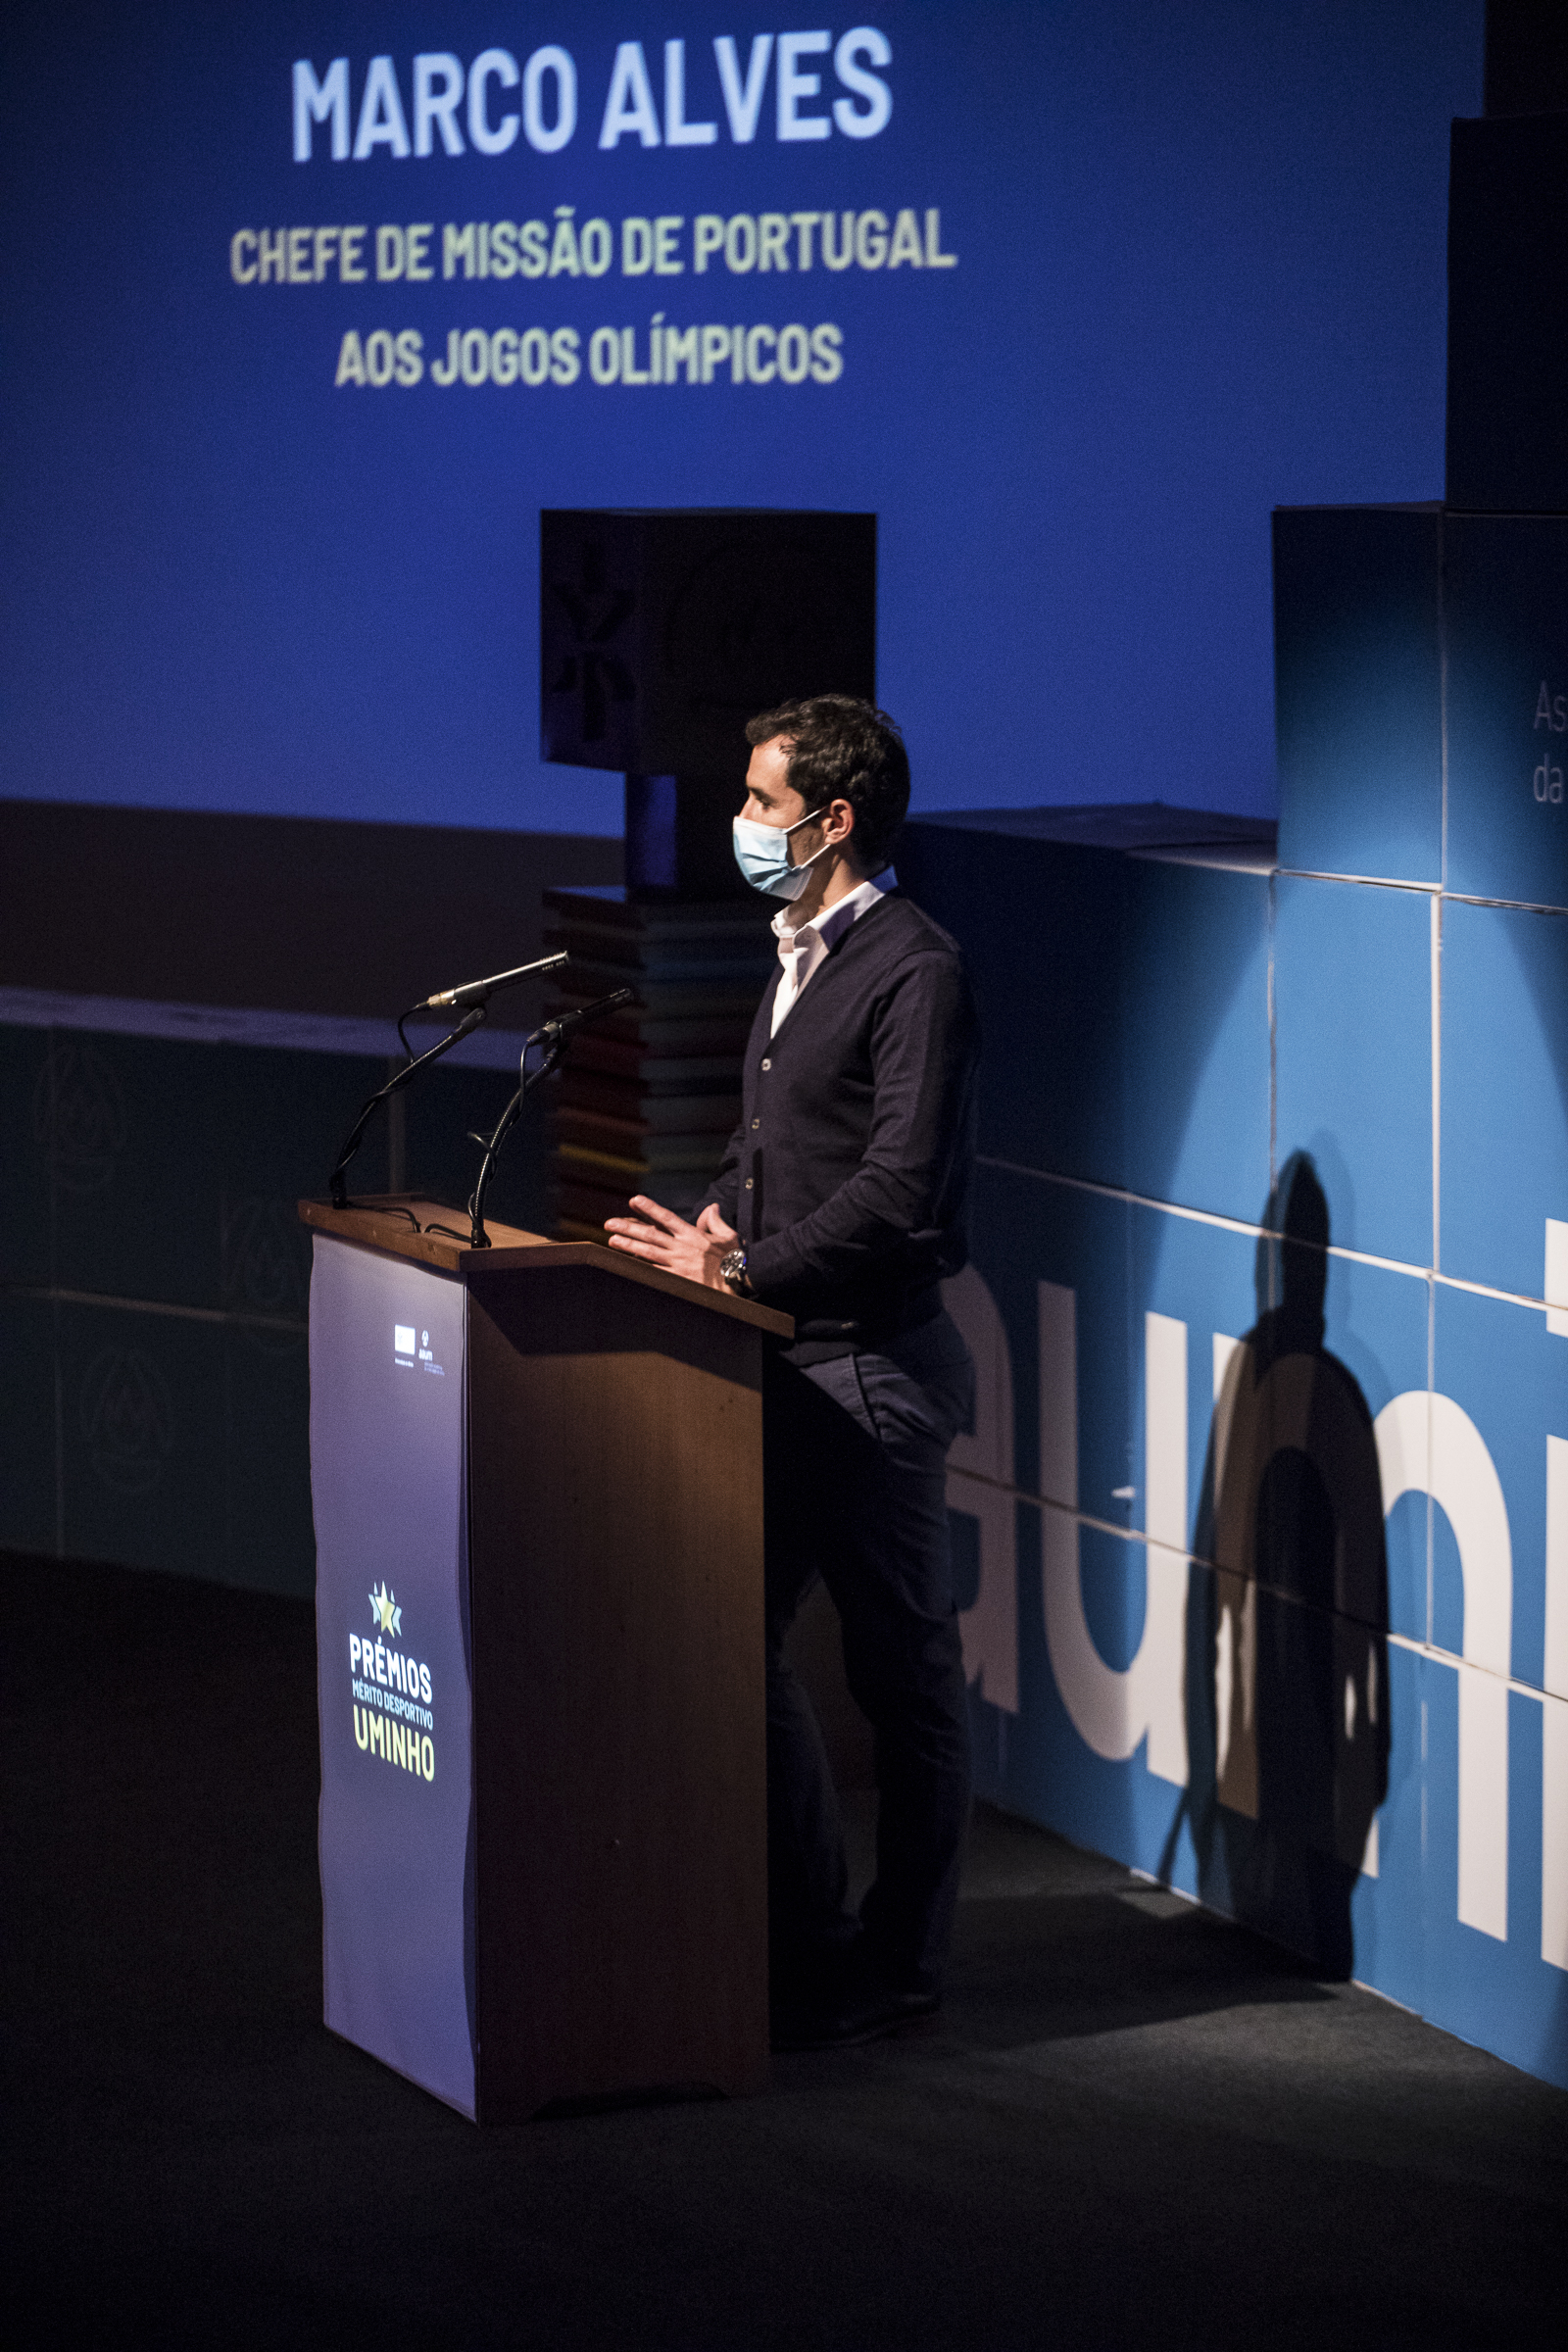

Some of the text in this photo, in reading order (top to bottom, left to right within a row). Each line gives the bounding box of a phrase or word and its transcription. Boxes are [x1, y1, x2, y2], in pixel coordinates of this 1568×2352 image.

[293, 25, 893, 162] MARCO ALVES
[230, 205, 958, 284] CHEFE DE MISSÃO DE PORTUGAL
[335, 312, 844, 387] AOS JOGOS OLÍMPICOS
[1533, 753, 1564, 804] da
[350, 1634, 432, 1703] PRÉMIOS
[352, 1678, 433, 1731] MÉRITO DESPORTIVO
[353, 1703, 435, 1782] UMINHO
